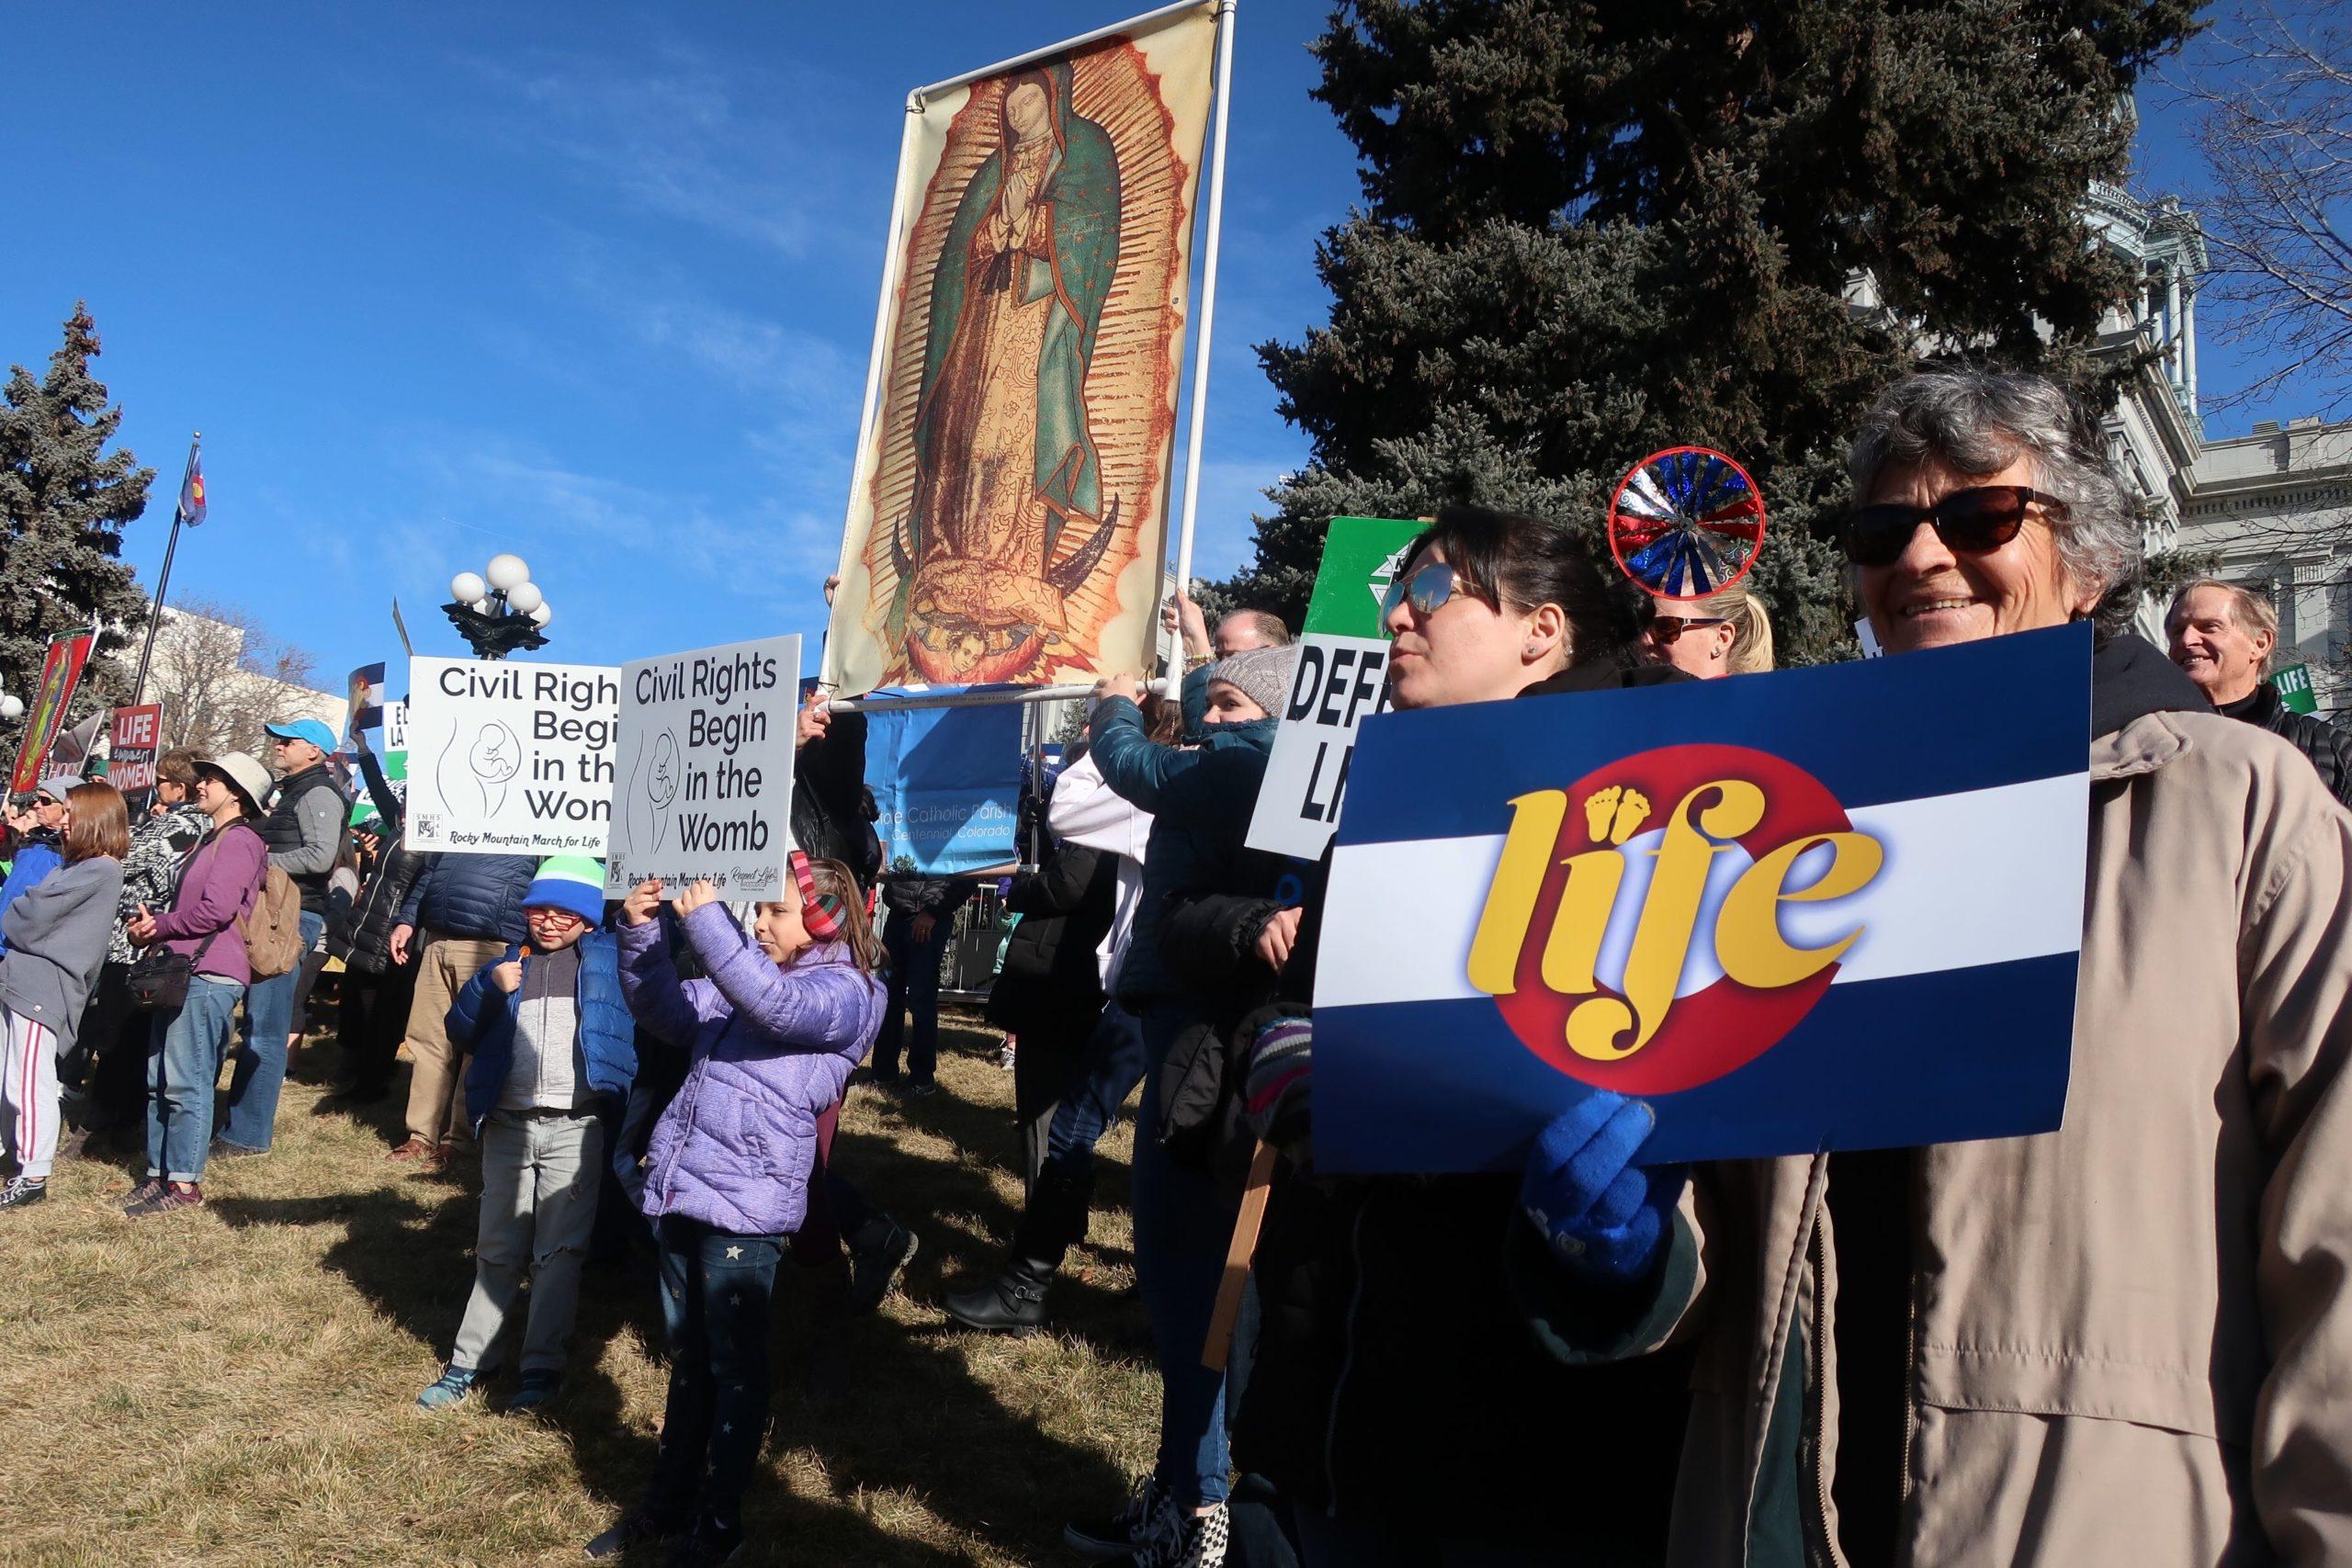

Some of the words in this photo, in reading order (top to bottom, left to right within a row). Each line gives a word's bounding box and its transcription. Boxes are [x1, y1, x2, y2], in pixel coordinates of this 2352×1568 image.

[439, 667, 523, 700] Civil
[535, 671, 617, 712] Righ
[636, 662, 684, 705] Civil
[692, 652, 776, 705] Rights
[2276, 668, 2308, 695] LIFE
[119, 714, 153, 745] LIFE
[534, 710, 617, 750] Begi
[689, 703, 766, 755] Begin
[107, 761, 153, 790] WOMEN
[533, 750, 564, 782] in
[578, 753, 614, 783] th
[685, 762, 706, 801] in
[717, 759, 762, 798] the
[908, 804, 967, 824] Catholic
[972, 802, 1012, 820] Parish
[449, 830, 480, 845] Rocky
[482, 832, 529, 847] Mountain
[532, 833, 562, 849] March
[563, 836, 578, 848] for
[582, 836, 601, 848] Life
[678, 810, 768, 852] Womb
[957, 825, 1011, 839] Colorado
[712, 873, 727, 889] Life
[1467, 779, 1883, 1062] life
